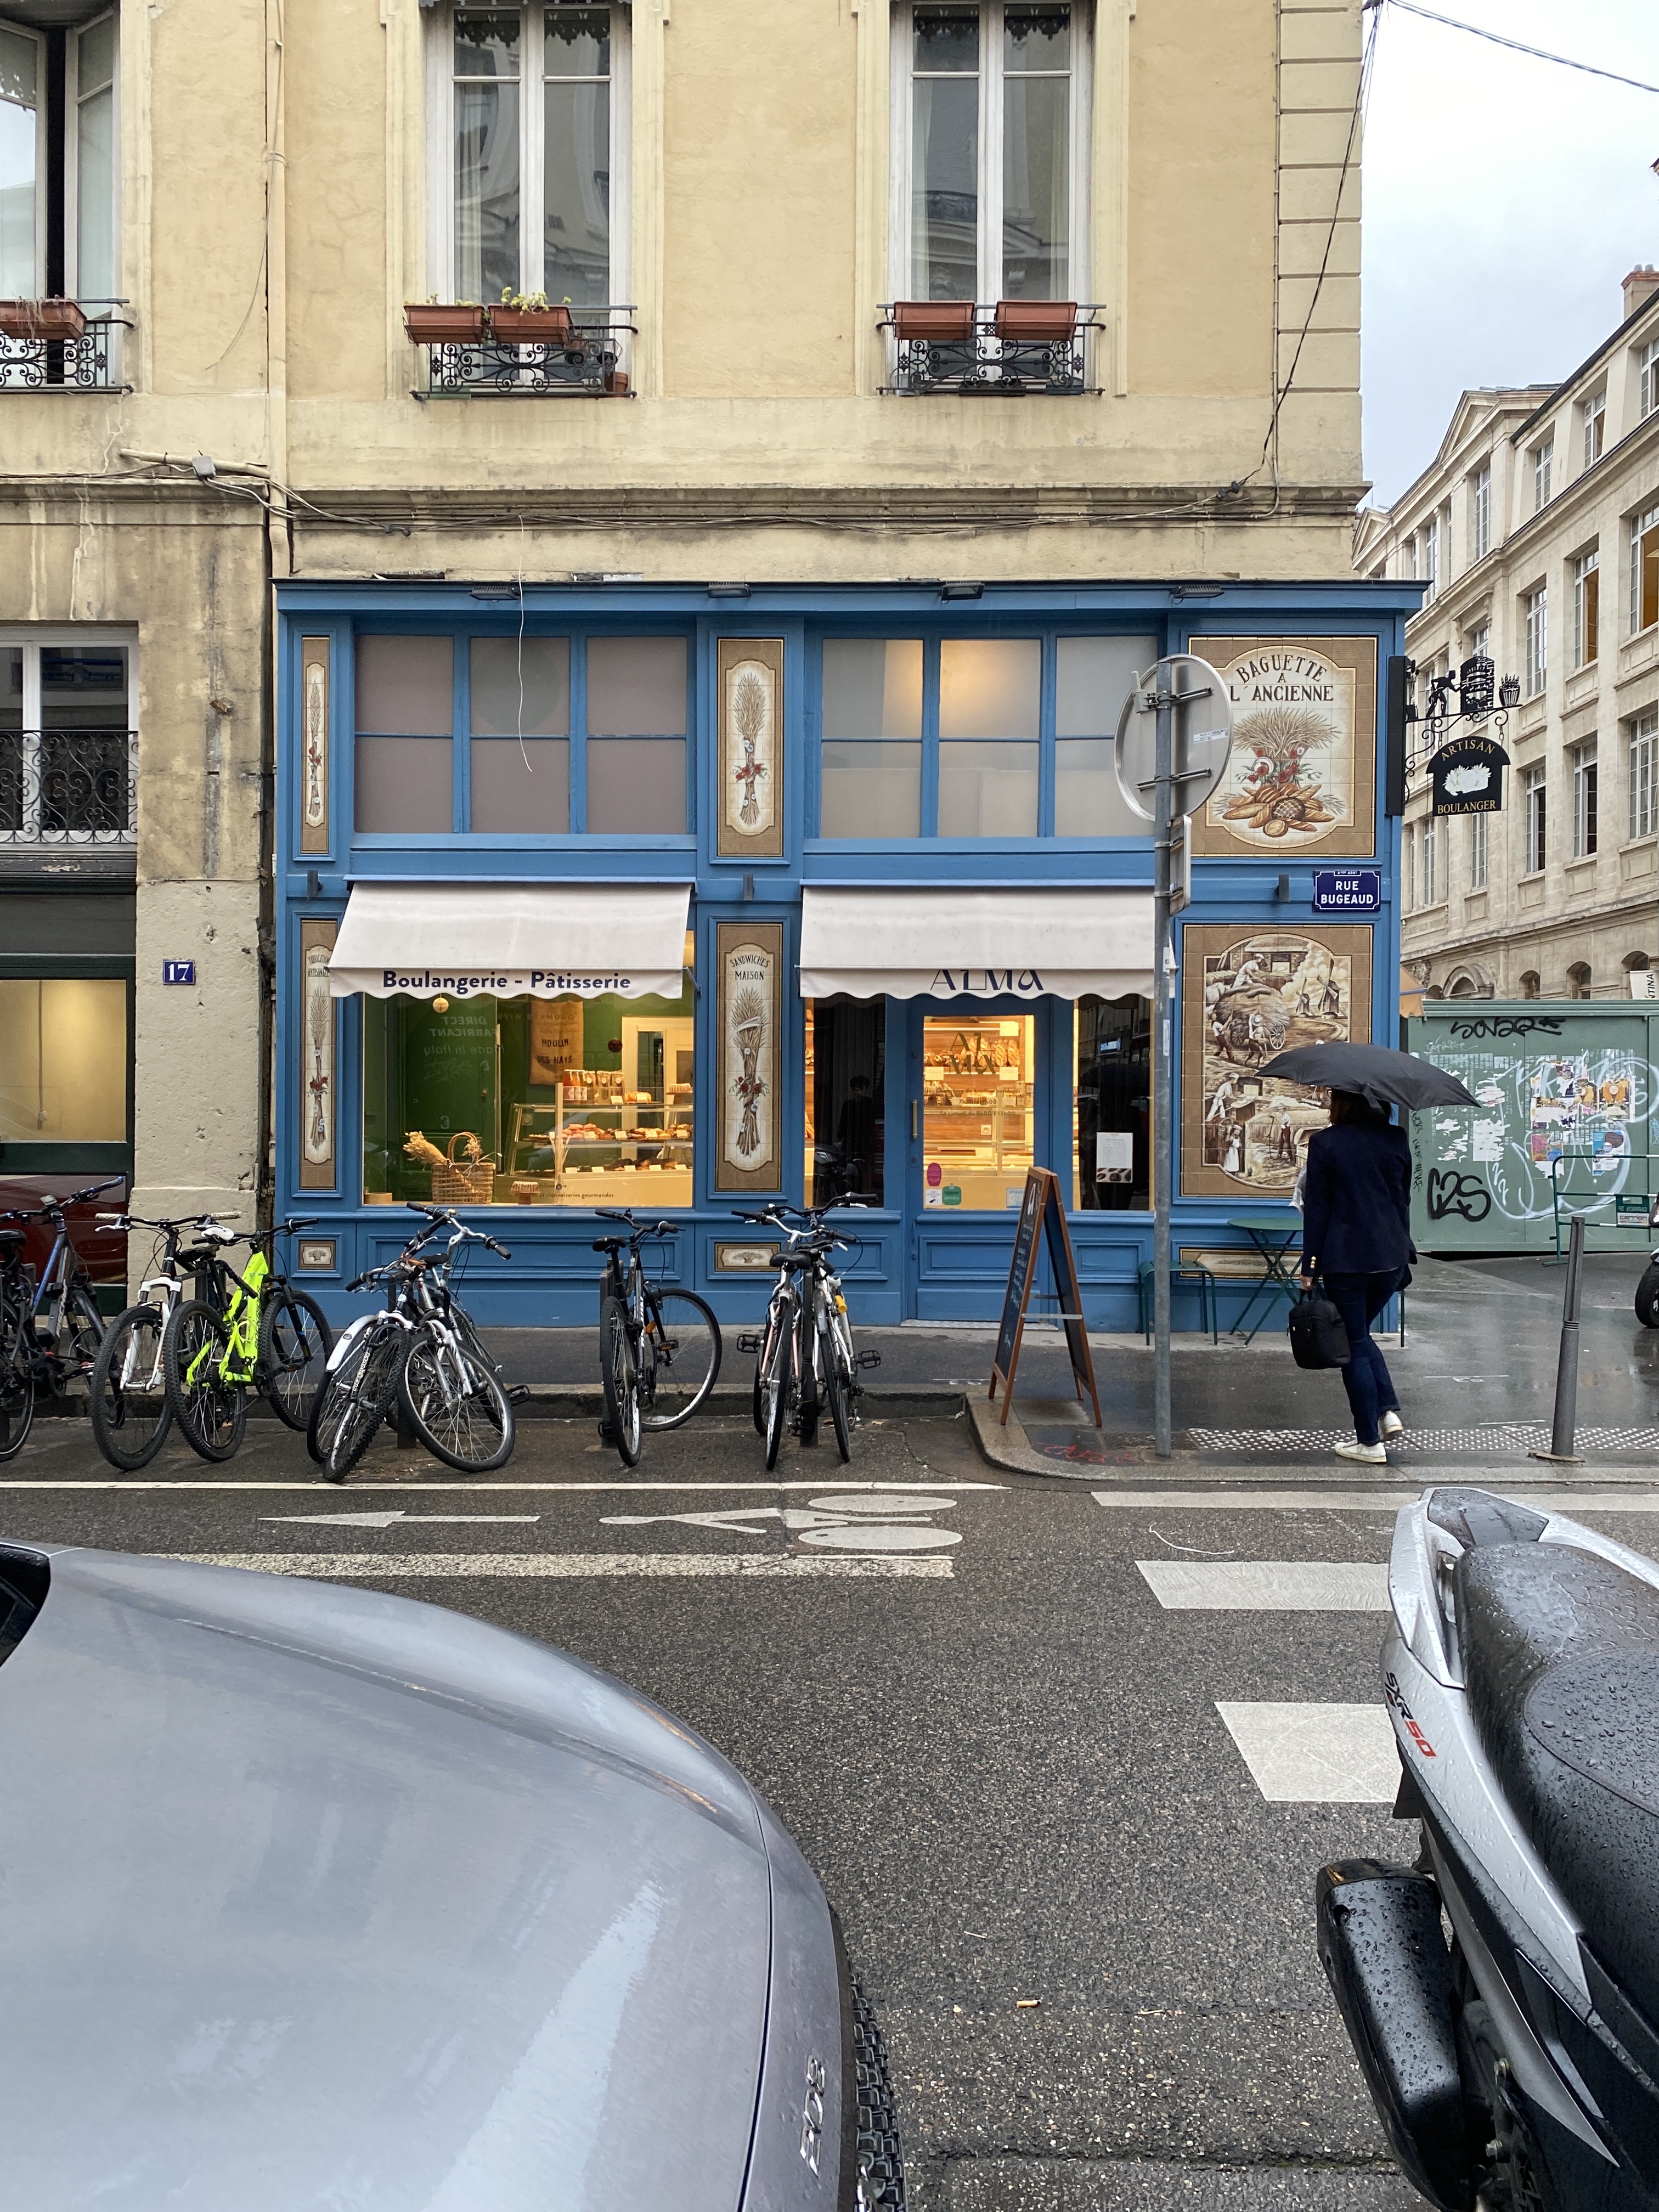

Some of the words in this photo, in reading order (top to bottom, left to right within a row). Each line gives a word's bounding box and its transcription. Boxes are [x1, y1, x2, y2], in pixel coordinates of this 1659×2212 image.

[1235, 654, 1327, 684] BAGUETTE
[1441, 740, 1495, 761] ARTISAN
[1437, 799, 1496, 814] BOULANGER
[1335, 881, 1359, 890] RUE
[1321, 894, 1374, 904] BUGEAUD
[730, 955, 770, 968] SANDWICHES
[168, 963, 190, 981] 17
[735, 970, 764, 980] MAISON
[383, 970, 508, 995] Boulangerie
[531, 971, 630, 989] Pâtisserie
[541, 1038, 569, 1047] MOULIN
[537, 1056, 550, 1064] DES
[554, 1056, 572, 1064] HAYS
